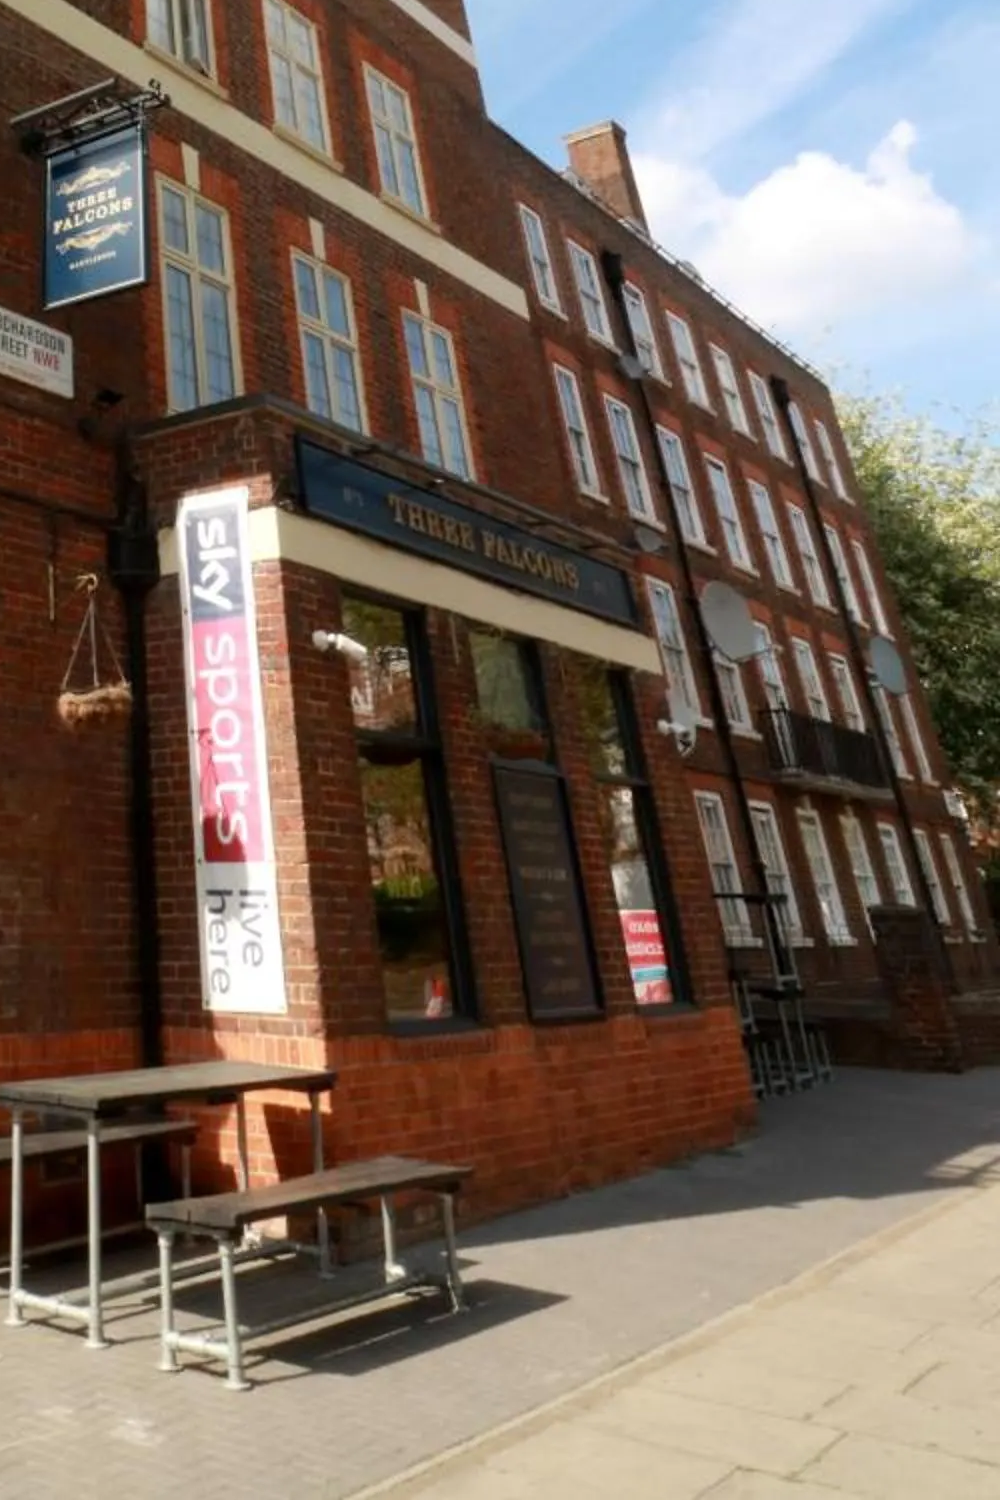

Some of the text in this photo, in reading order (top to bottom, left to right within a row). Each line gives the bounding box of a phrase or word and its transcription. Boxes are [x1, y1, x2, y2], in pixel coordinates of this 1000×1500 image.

[52, 197, 133, 236] FALCONS
[66, 186, 117, 213] THREE
[387, 493, 476, 551] THREE
[481, 530, 580, 590] FALCONS
[192, 517, 250, 845] sky sports
[205, 888, 234, 994] here
[239, 888, 268, 968] live
